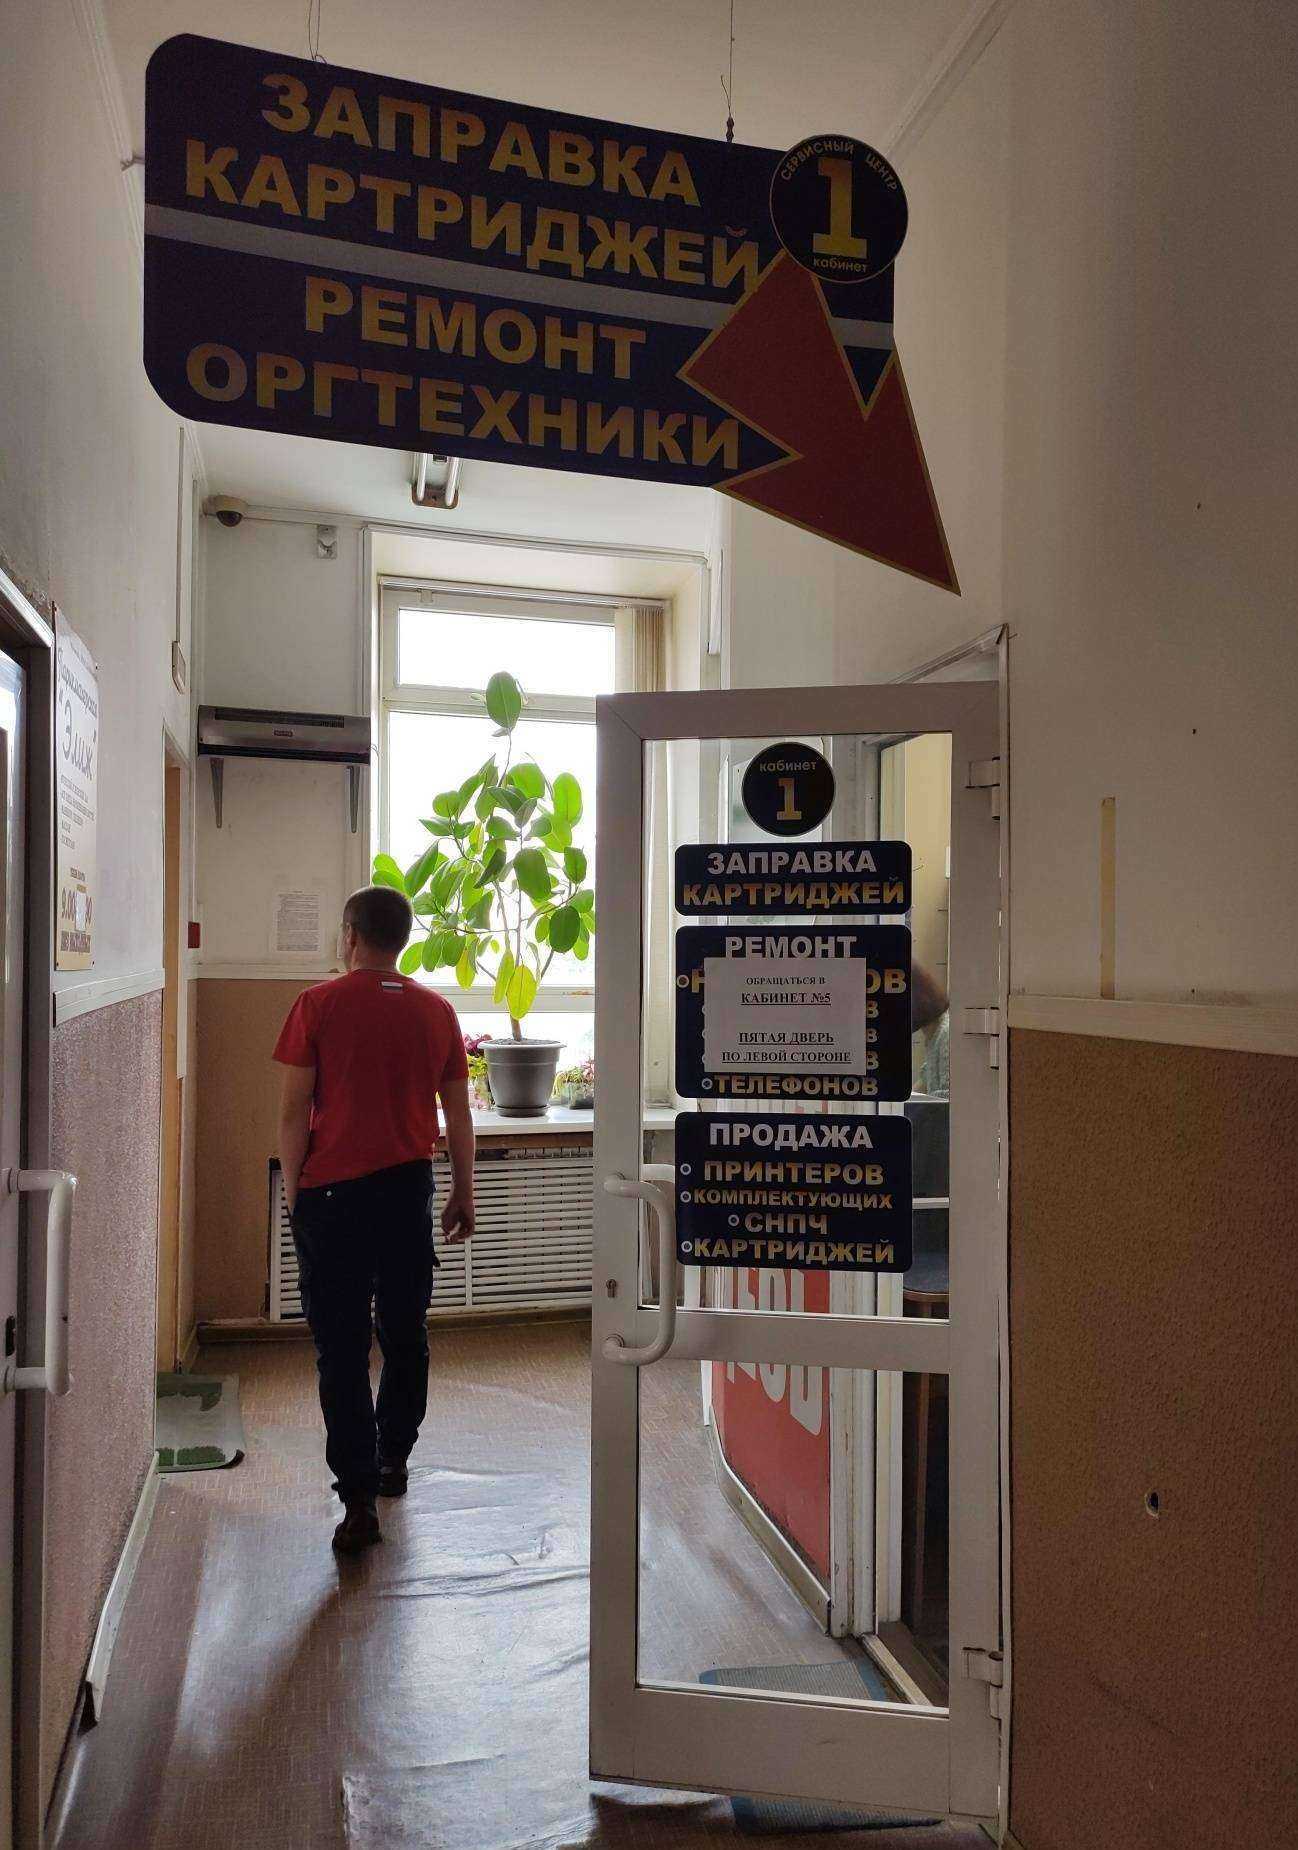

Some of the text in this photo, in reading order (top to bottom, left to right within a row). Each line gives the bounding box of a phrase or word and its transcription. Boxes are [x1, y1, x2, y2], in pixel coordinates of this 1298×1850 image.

[261, 73, 701, 206] ЗАПРАВКА
[780, 140, 898, 191] СЕРВИСНЫЙ ЦЕНТР
[185, 139, 760, 289] КАРТРИДЖЕЙ
[812, 157, 868, 259] 1
[813, 257, 867, 273] кабинет
[304, 275, 648, 380] РЕМОНТ
[186, 342, 740, 470] ОРГТЕХНИКИ
[759, 759, 817, 774] кабинет
[776, 777, 802, 821] 1
[707, 849, 877, 875] ЗАПРАВКА
[683, 876, 905, 909] КАРТРИДЖЕЙ
[725, 935, 858, 959] РЕМОНТ
[746, 976, 827, 986] ОБРАЩАТЬСЯ В
[740, 992, 832, 1004] КАБИНЕТ №5
[739, 1032, 834, 1045] ПЯТАЯ ДВЕРЬ
[722, 1051, 740, 1062] ПО
[743, 1049, 787, 1062] ЛЕВОЙ
[790, 1051, 852, 1063] СТОРОНЕ
[714, 1075, 879, 1096] ТЕЛЕФОНОВ
[709, 1122, 874, 1151] ПРОДАЖА
[704, 1160, 885, 1186] ПРИНТЕРОВ
[693, 1188, 893, 1211] КОМПЛЕКТУЮЩИХ
[744, 1212, 828, 1235] СНПЧ
[694, 1239, 895, 1265] КАРТРИДЖЕЙ
